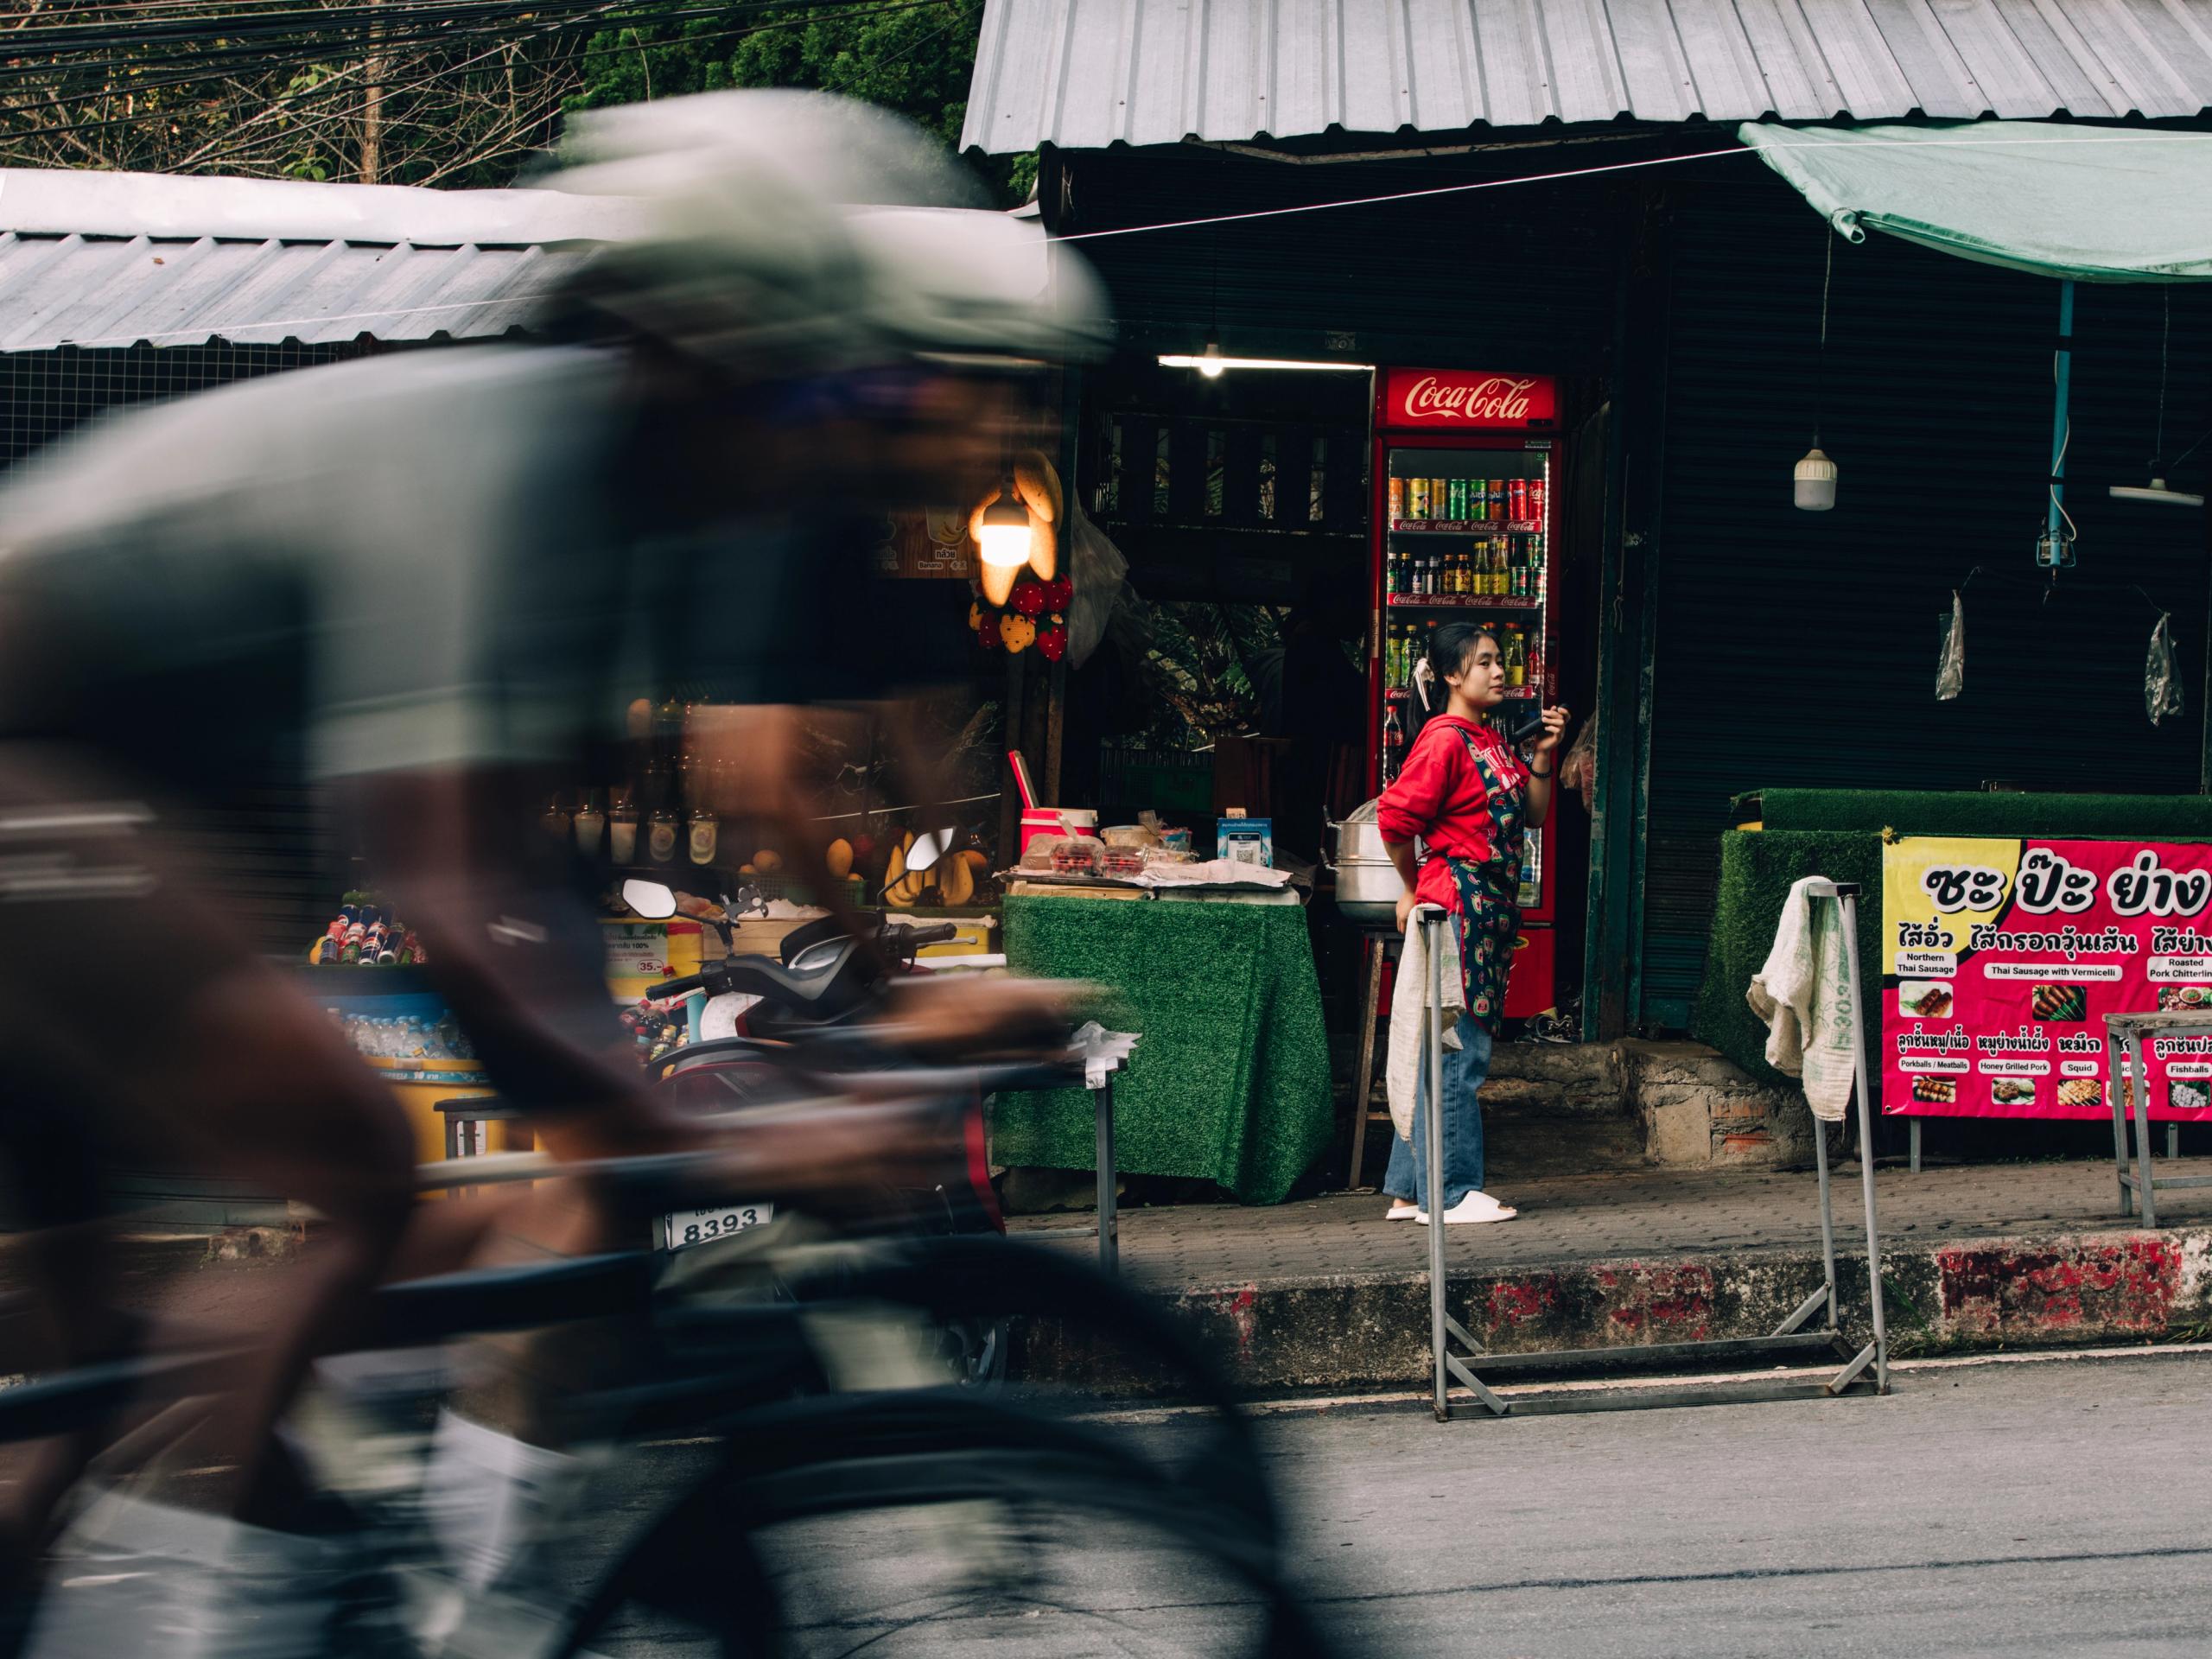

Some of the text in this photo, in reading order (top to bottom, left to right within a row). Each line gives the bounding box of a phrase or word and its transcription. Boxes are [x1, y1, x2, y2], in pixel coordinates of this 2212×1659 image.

[1404, 376, 1537, 419] Coca-Cola
[1923, 851, 2209, 912] ซะ ป๊ะ ย่าง
[1897, 916, 1954, 949] ไส้อั่ว
[1970, 925, 2138, 959] ไส้กรอกวุ้นเส้น
[1907, 953, 1944, 962] Northern
[2169, 958, 2203, 967] Roasted
[639, 962, 662, 971] 35.-
[1918, 964, 1955, 975] Sausage
[2012, 967, 2050, 976] Sausage
[2071, 968, 2115, 976] Vermicelli
[1978, 1027, 2049, 1056] หมูย่างน้ำผึ้ง
[2058, 1033, 2101, 1052] หมึก
[1901, 1059, 1932, 1068] Porkballs
[1937, 1060, 1967, 1070] Meatballs
[1980, 1063, 2003, 1071] Honey
[2068, 1064, 2093, 1074] Squid
[683, 1208, 758, 1243] 8393
